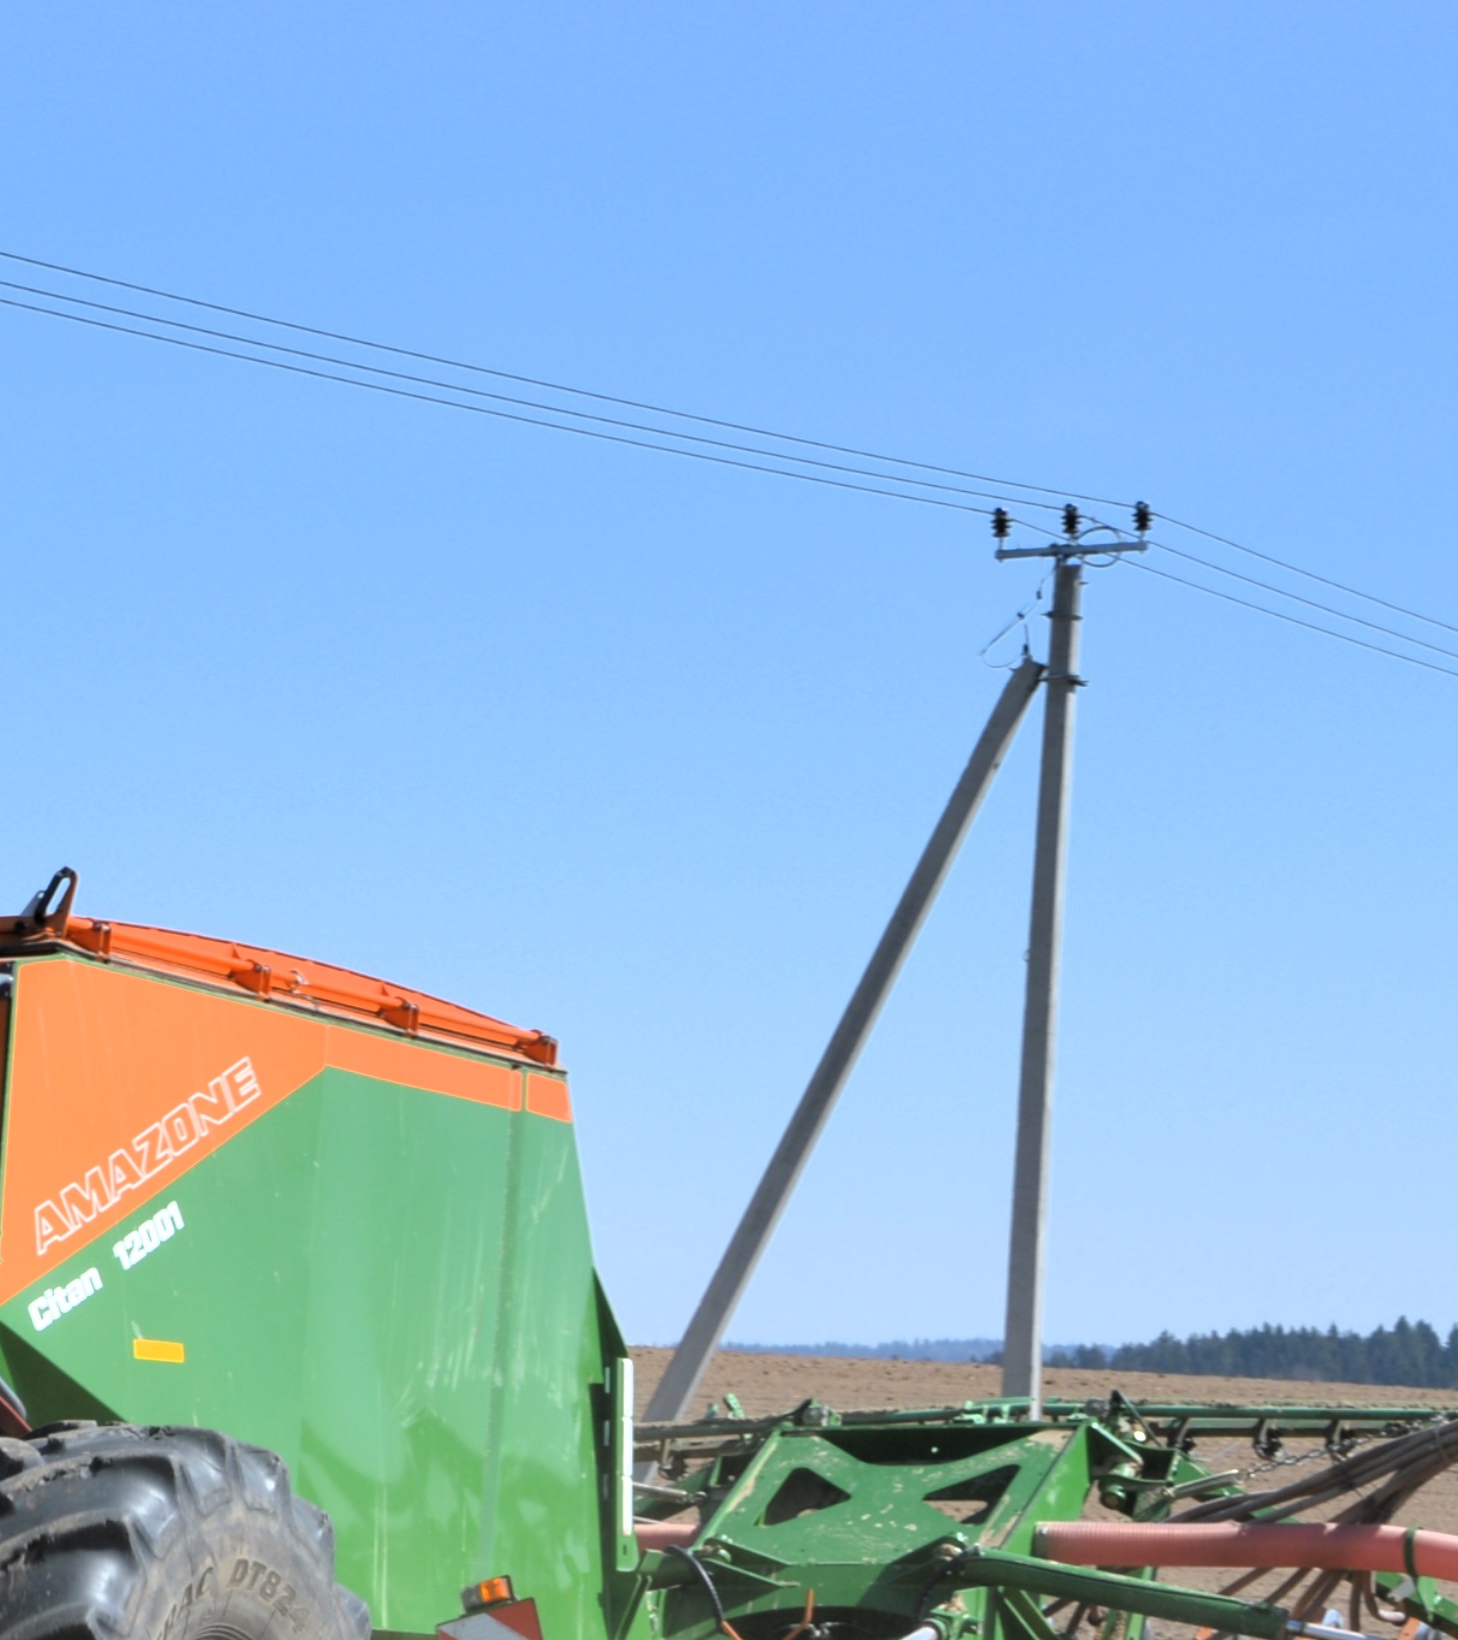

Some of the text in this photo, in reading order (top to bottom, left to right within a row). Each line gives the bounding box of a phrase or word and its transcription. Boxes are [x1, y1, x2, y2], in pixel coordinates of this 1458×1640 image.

[34, 1055, 262, 1256] AMAZONE
[27, 1200, 185, 1331] Citan 12001
[227, 1557, 311, 1635] DT824
